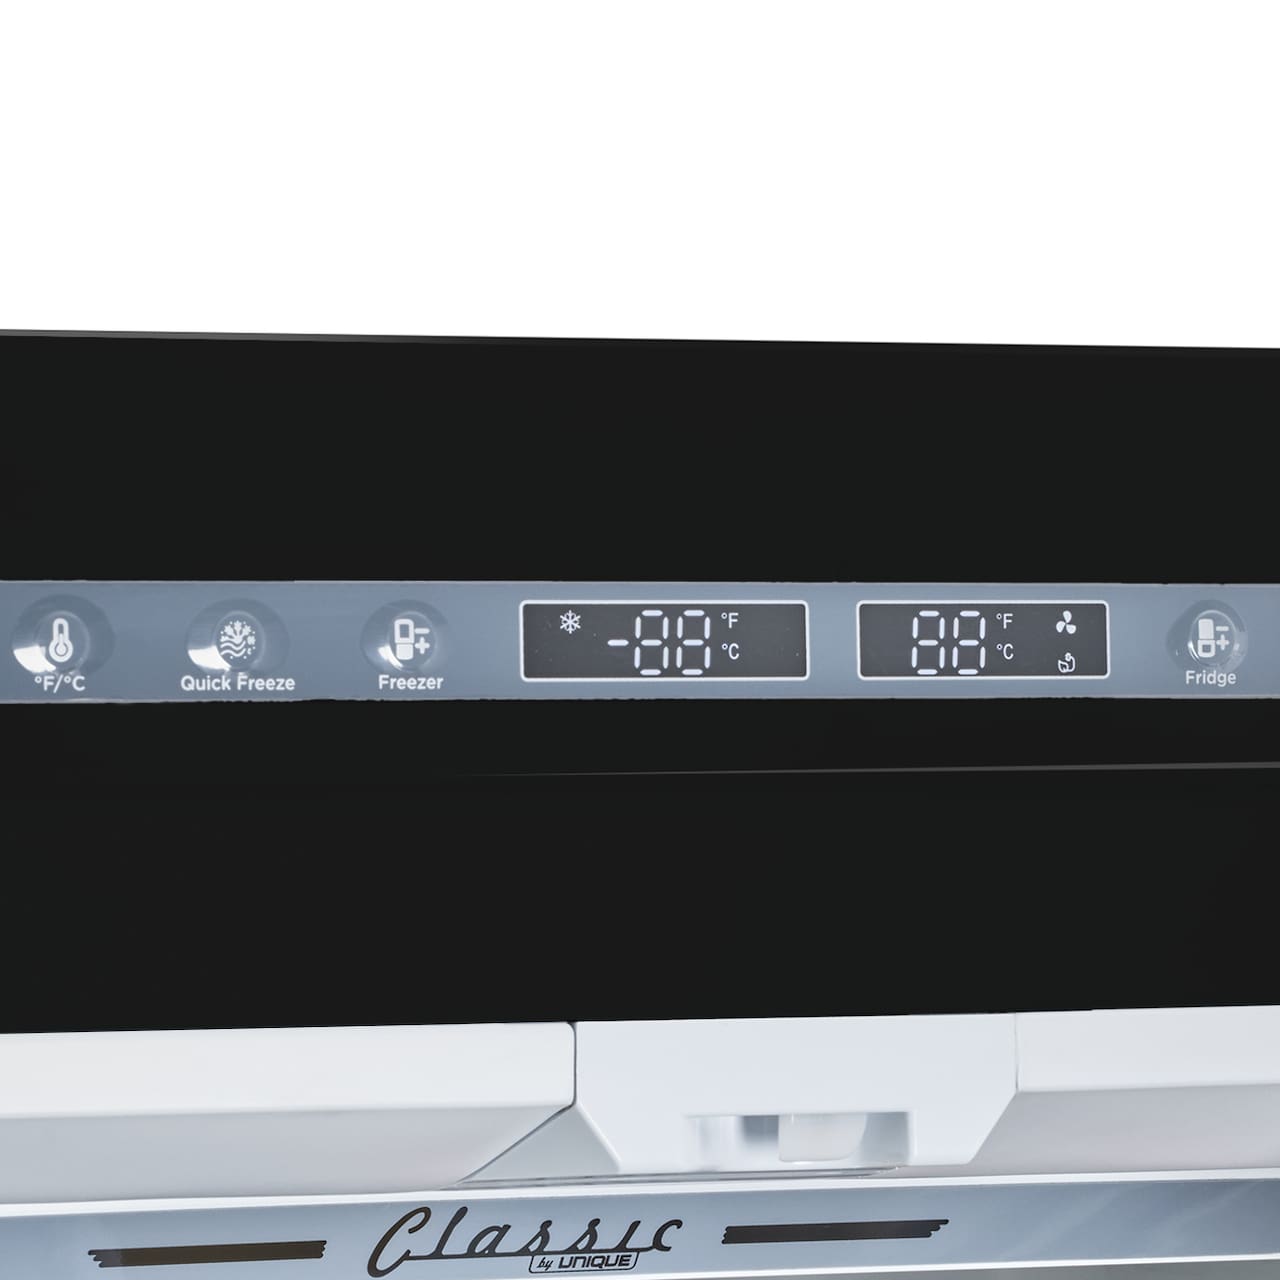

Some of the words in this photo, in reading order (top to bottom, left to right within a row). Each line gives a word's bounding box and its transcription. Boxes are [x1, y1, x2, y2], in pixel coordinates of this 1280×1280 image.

[911, 610, 986, 675] 88
[34, 675, 85, 694] °F/°C
[181, 675, 231, 694] Quick
[237, 674, 295, 691] Freeze
[379, 674, 444, 691] Freezer
[1185, 670, 1237, 689] Fridge
[367, 1206, 683, 1278] Classic
[537, 1256, 553, 1271] by
[558, 1253, 632, 1269] UNIQUE
